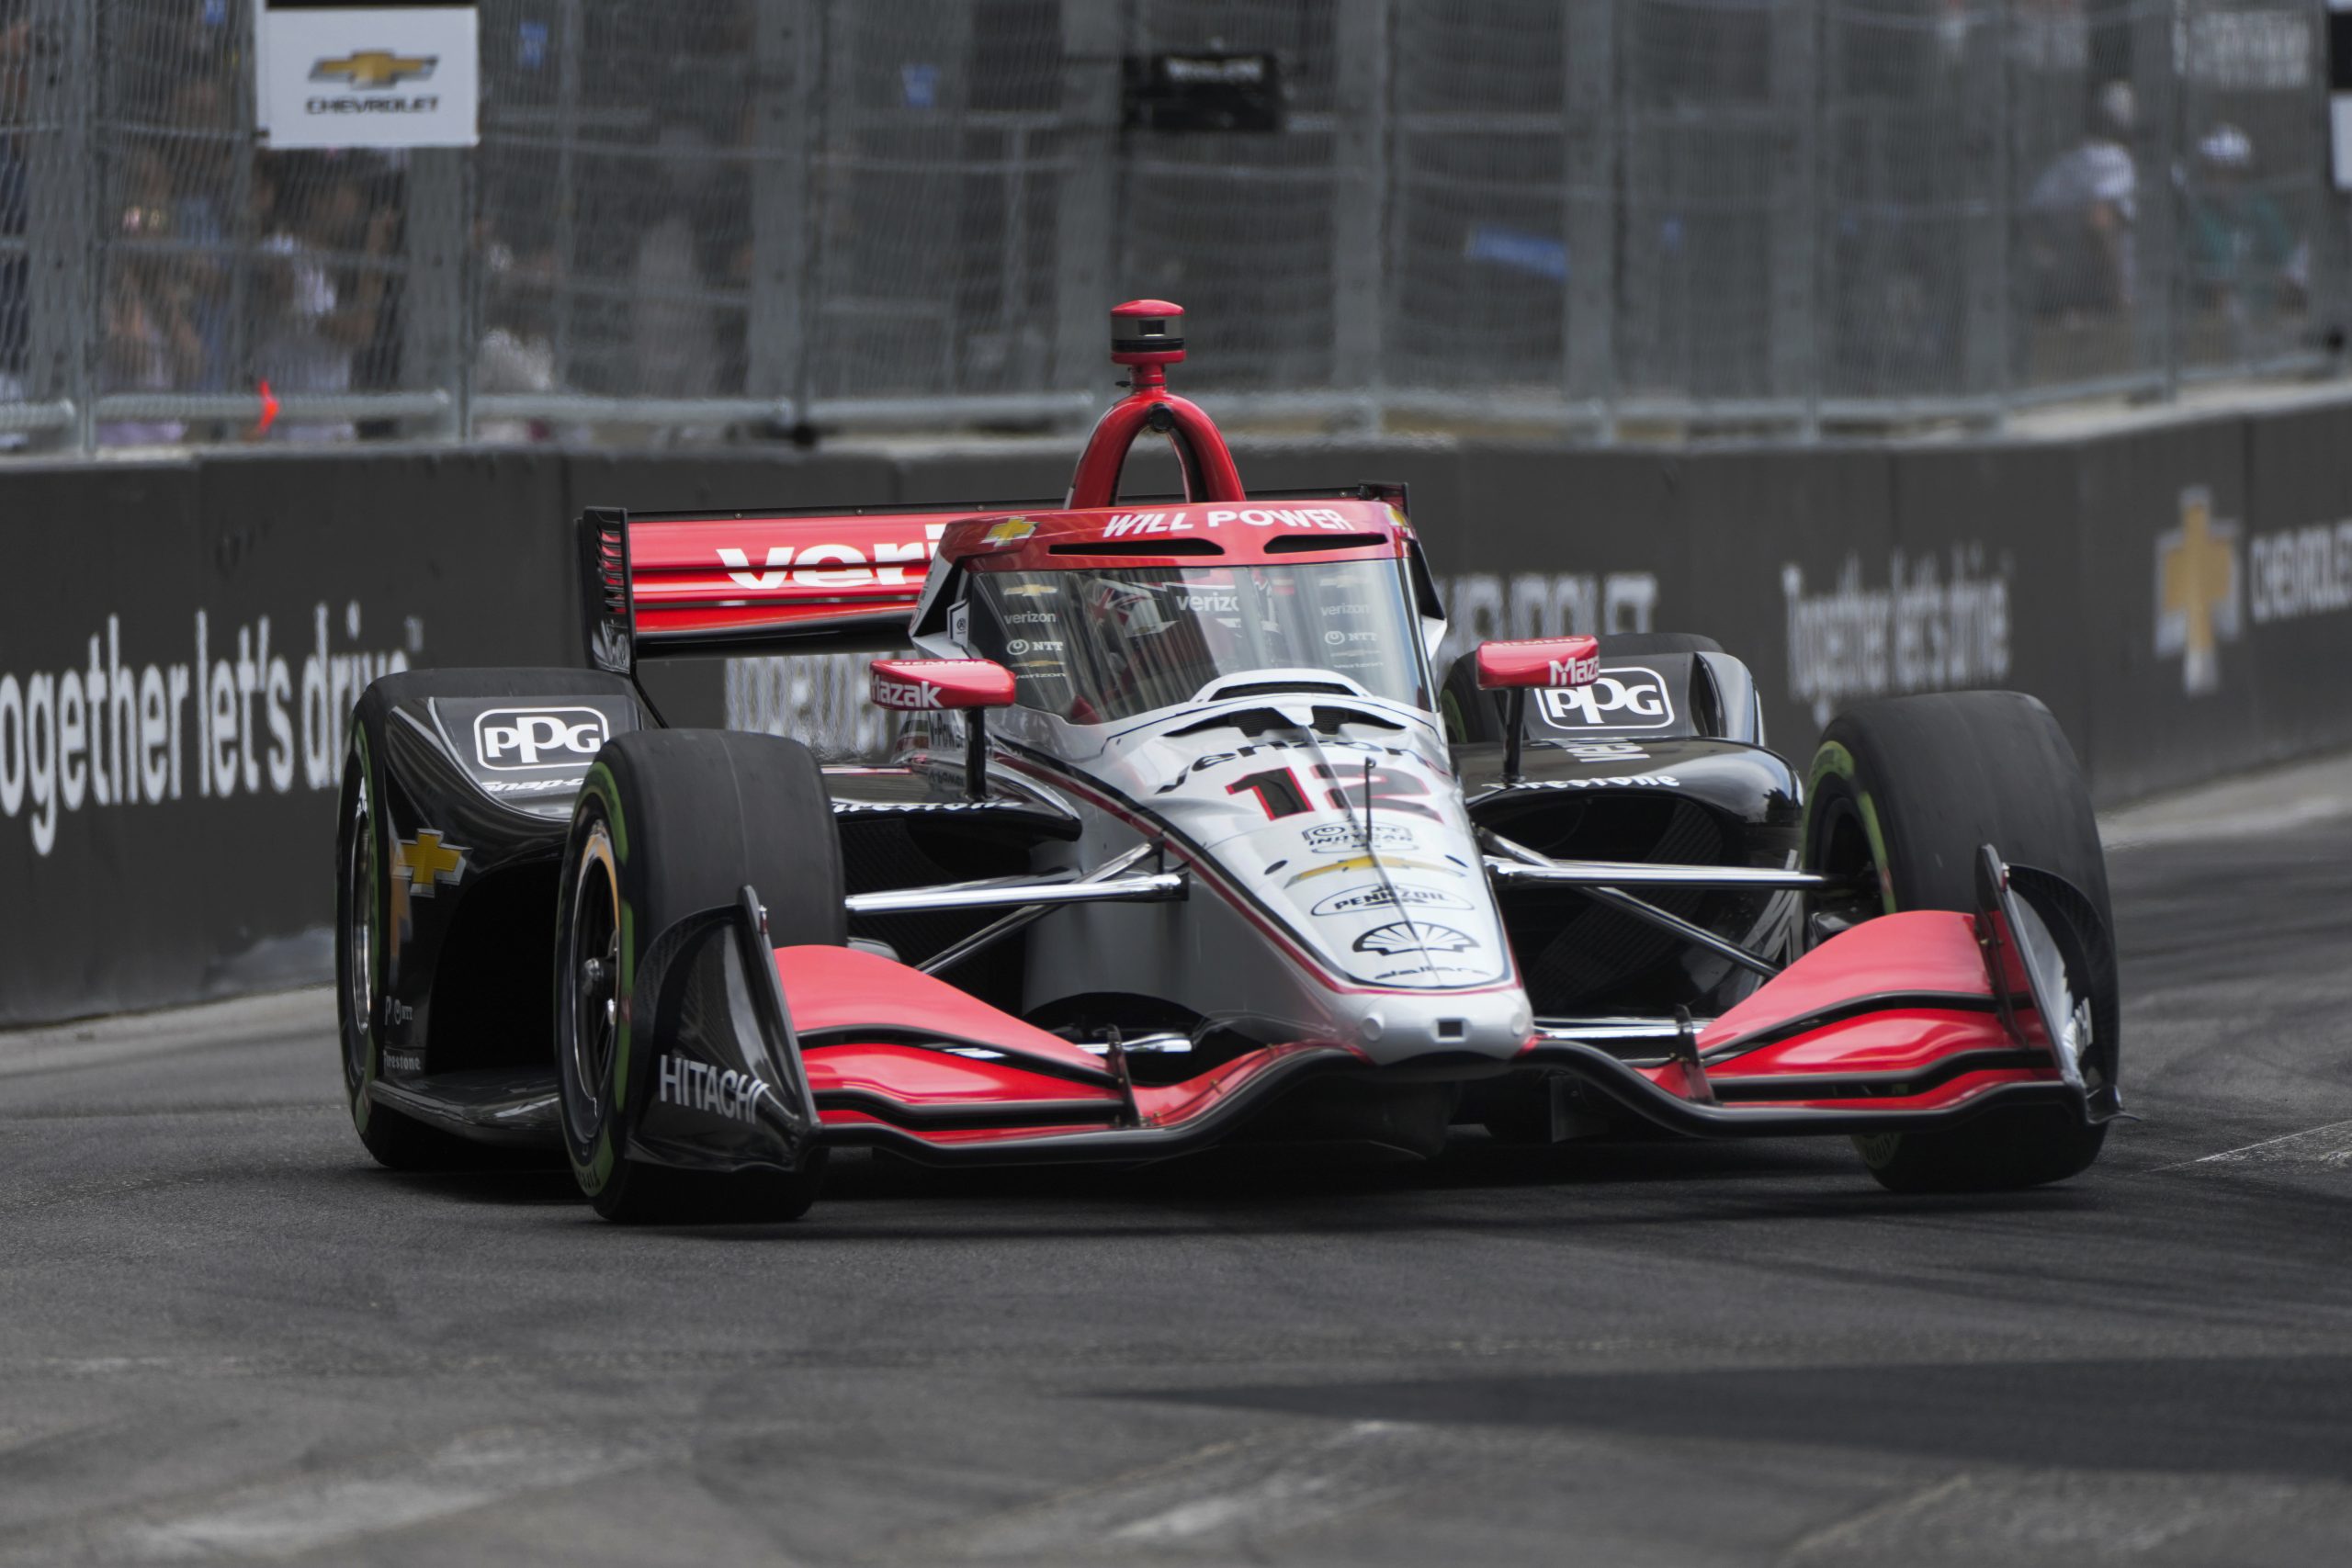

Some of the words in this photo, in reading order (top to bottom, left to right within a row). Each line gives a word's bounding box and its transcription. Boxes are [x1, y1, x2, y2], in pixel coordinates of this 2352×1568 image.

[306, 96, 438, 114] CHEVROLET
[1102, 513, 1193, 536] WILL
[1207, 508, 1356, 531] POWER
[1003, 610, 1057, 625] verizon
[1320, 603, 1373, 616] verizon
[1033, 641, 1064, 651] NTT
[1348, 632, 1378, 641] NTT
[194, 606, 297, 797] let's
[1544, 678, 1665, 724] PPG
[484, 716, 602, 763] PPG
[1225, 762, 1444, 824] 12
[831, 797, 1023, 813] irestone
[660, 1055, 770, 1125] HITACHI
